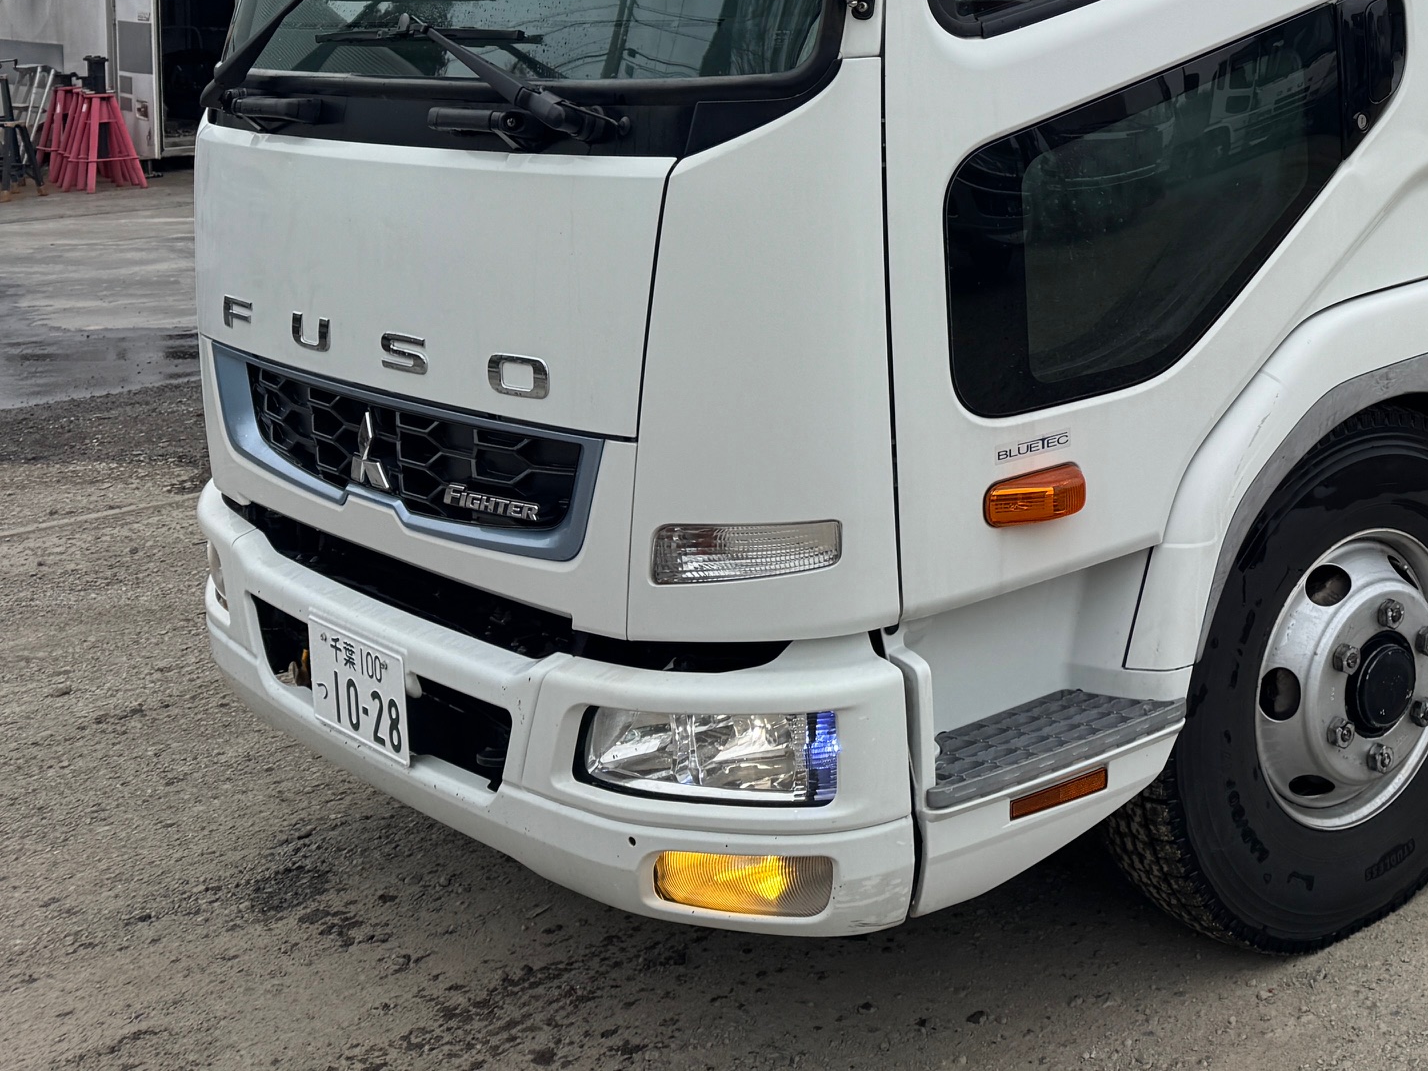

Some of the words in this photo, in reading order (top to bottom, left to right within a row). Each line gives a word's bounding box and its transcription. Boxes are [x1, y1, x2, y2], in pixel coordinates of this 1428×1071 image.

[222, 295, 551, 399] FUSO
[997, 431, 1069, 461] BLUETEC
[443, 483, 540, 521] FIGHTER
[330, 637, 356, 672] 千葉
[360, 648, 382, 683] 100
[333, 670, 402, 754] 10-28
